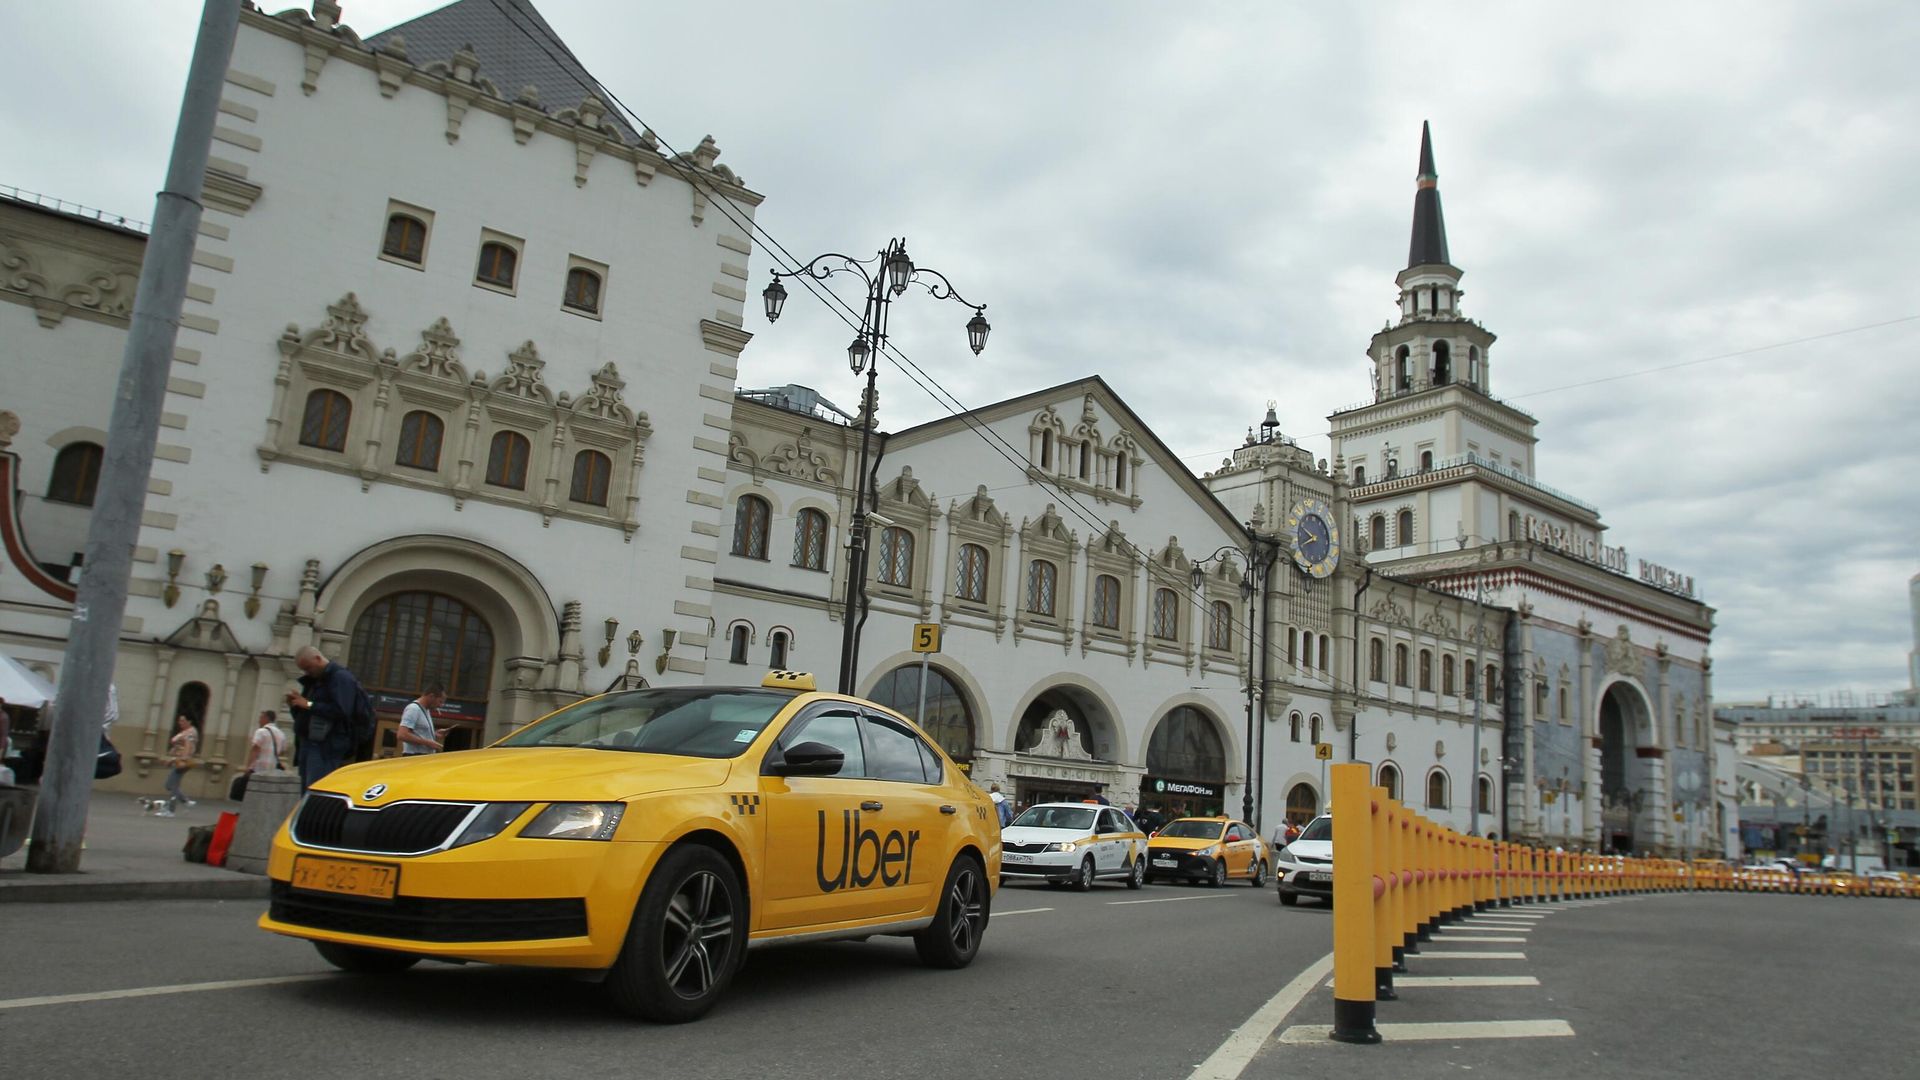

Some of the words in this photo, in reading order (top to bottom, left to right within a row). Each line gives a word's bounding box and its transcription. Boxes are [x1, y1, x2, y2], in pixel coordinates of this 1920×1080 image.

[1526, 515, 1629, 574] КАЗАНСКИЙ
[919, 628, 931, 647] 5
[1319, 745, 1328, 757] 4
[818, 810, 920, 893] Uber
